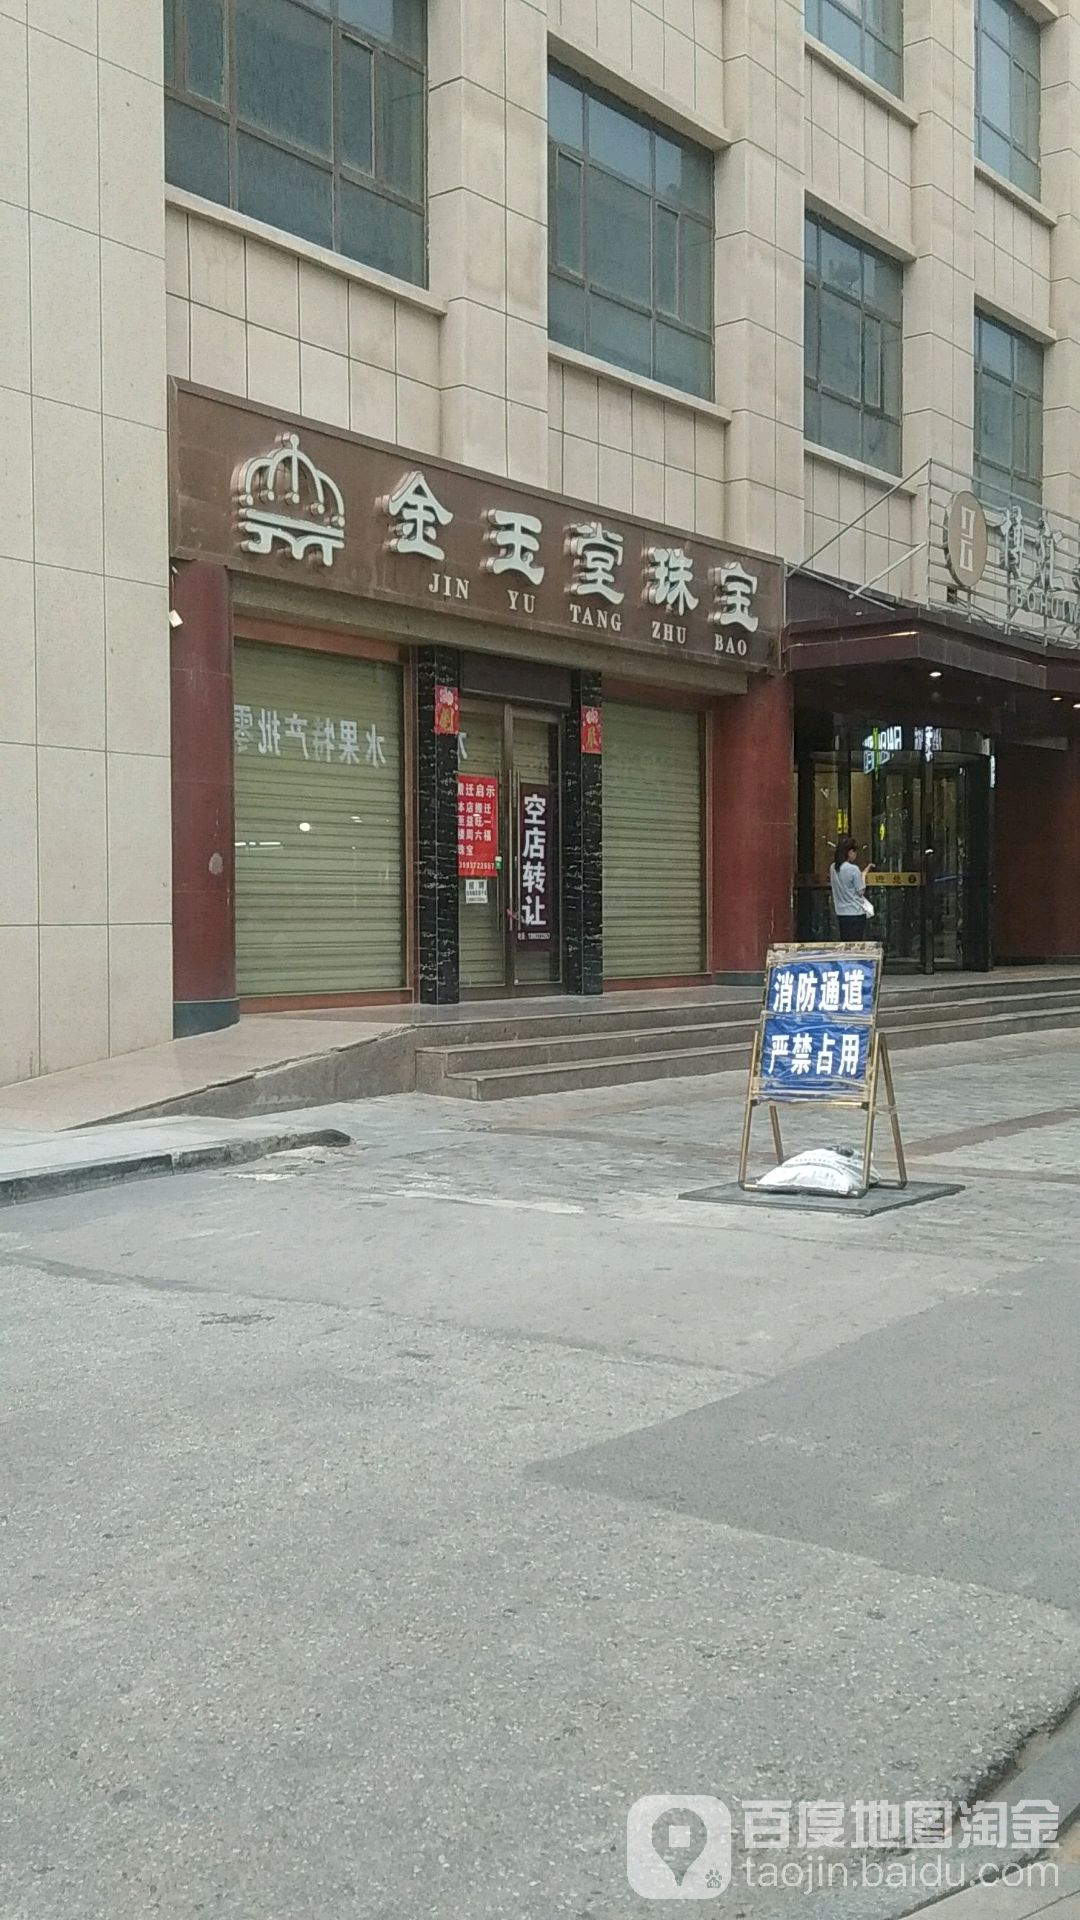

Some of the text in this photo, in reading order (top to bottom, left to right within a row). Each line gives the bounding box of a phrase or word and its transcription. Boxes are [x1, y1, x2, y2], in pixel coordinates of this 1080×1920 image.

[378, 470, 760, 633] 金玉堂珠宝
[428, 572, 748, 656] JIN YU TANG ZHU BAO
[522, 793, 547, 926] 空店转让
[772, 969, 865, 1013] 消防通道
[768, 1033, 861, 1076] 严禁占用
